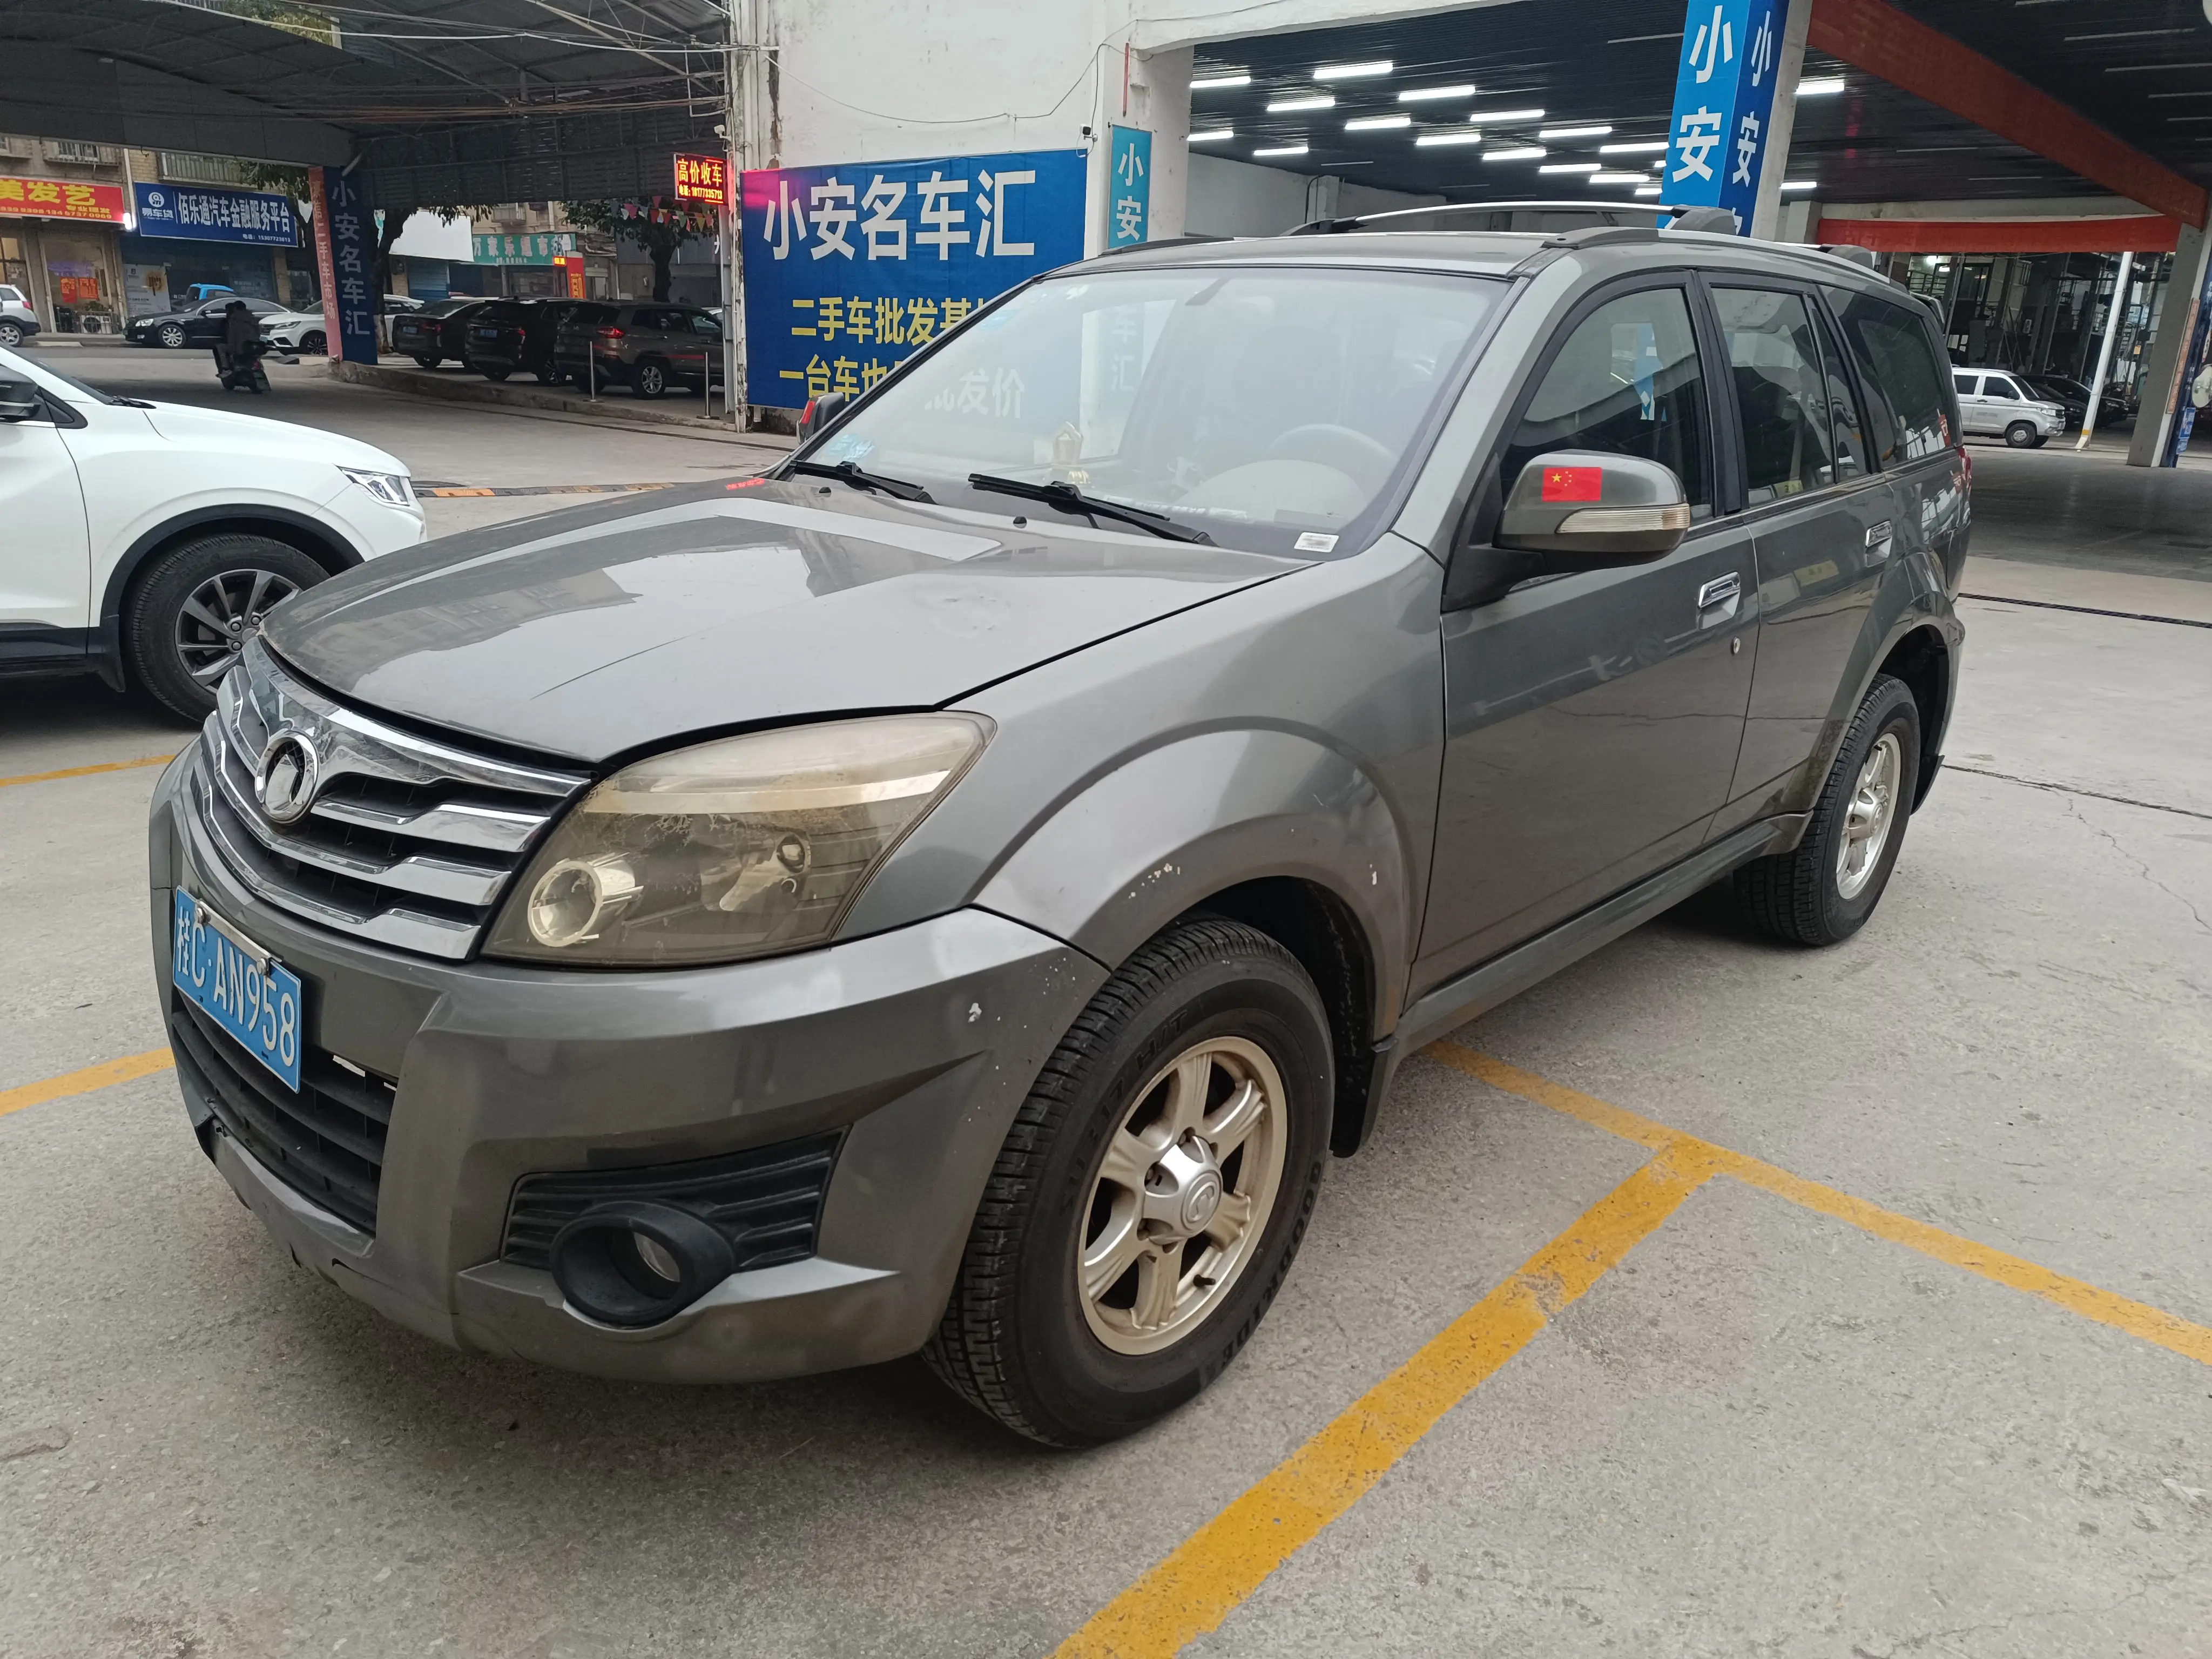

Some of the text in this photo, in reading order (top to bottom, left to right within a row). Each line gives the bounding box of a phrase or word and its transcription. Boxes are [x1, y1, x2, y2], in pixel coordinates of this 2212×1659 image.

[1672, 4, 1733, 230] 小安
[677, 158, 723, 187] 高价收车
[1116, 142, 1144, 242] 小安
[178, 192, 291, 233] 佰乐通汽车金融服务平台
[763, 168, 1036, 261] 小安名车汇
[331, 180, 370, 336] 小安名车汇
[791, 296, 984, 346] 二手车批发基
[779, 353, 903, 404] 一台车也
